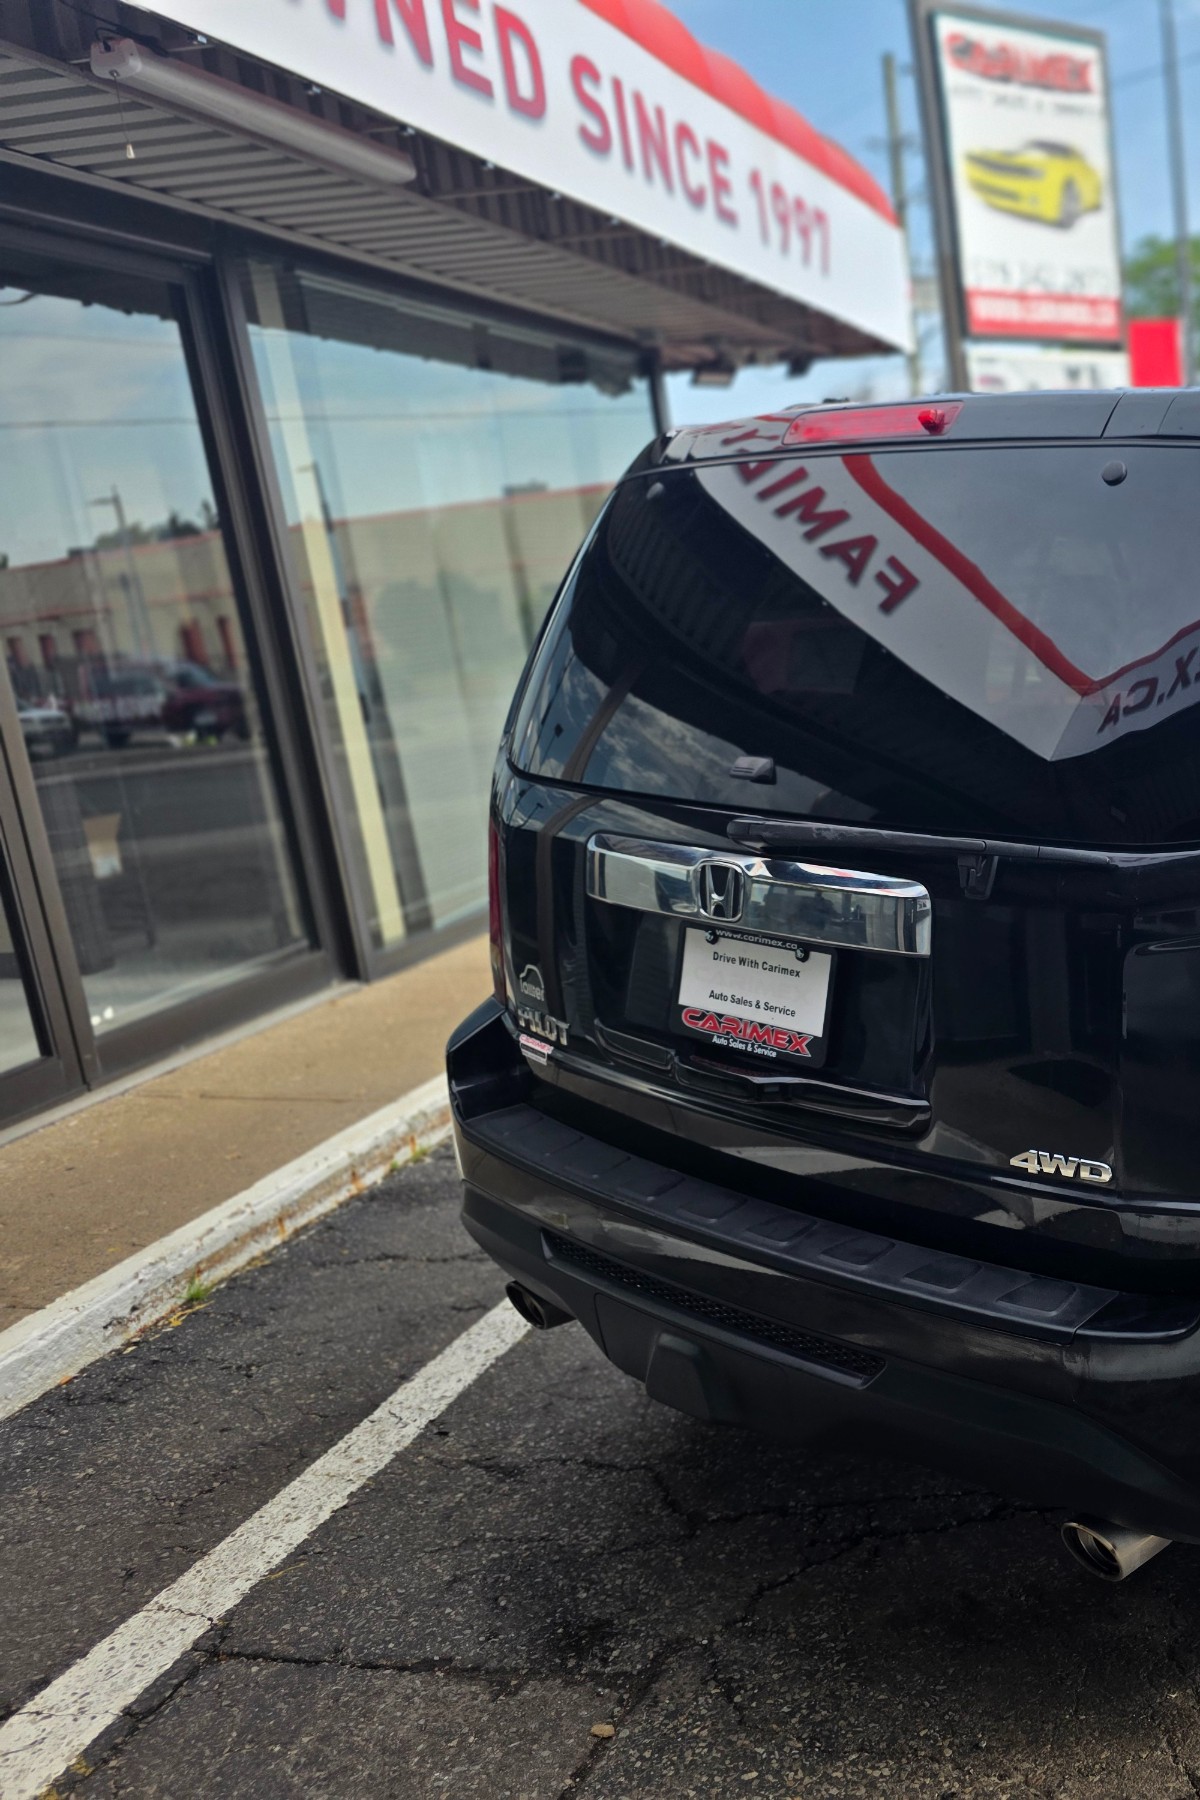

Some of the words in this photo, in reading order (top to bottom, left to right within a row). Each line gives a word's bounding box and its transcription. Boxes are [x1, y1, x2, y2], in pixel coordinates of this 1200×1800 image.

[300, 0, 547, 119] NED
[569, 53, 738, 228] SINCE
[749, 168, 832, 277] 1997
[715, 929, 798, 950] www.carimex.ca
[712, 951, 737, 965] Drive
[738, 956, 760, 970] With
[761, 961, 801, 978] Carimex
[708, 990, 728, 1003] Auto
[730, 994, 753, 1009] Sales
[754, 999, 761, 1009] &
[763, 1001, 796, 1018] Service
[517, 1006, 570, 1046] PILOT
[681, 1006, 814, 1058] CARIMEX
[712, 1034, 728, 1047] Auto
[728, 1038, 746, 1052] Sales
[746, 1042, 753, 1052] &
[753, 1044, 777, 1058] Service
[1009, 1149, 1113, 1183] 4WD
